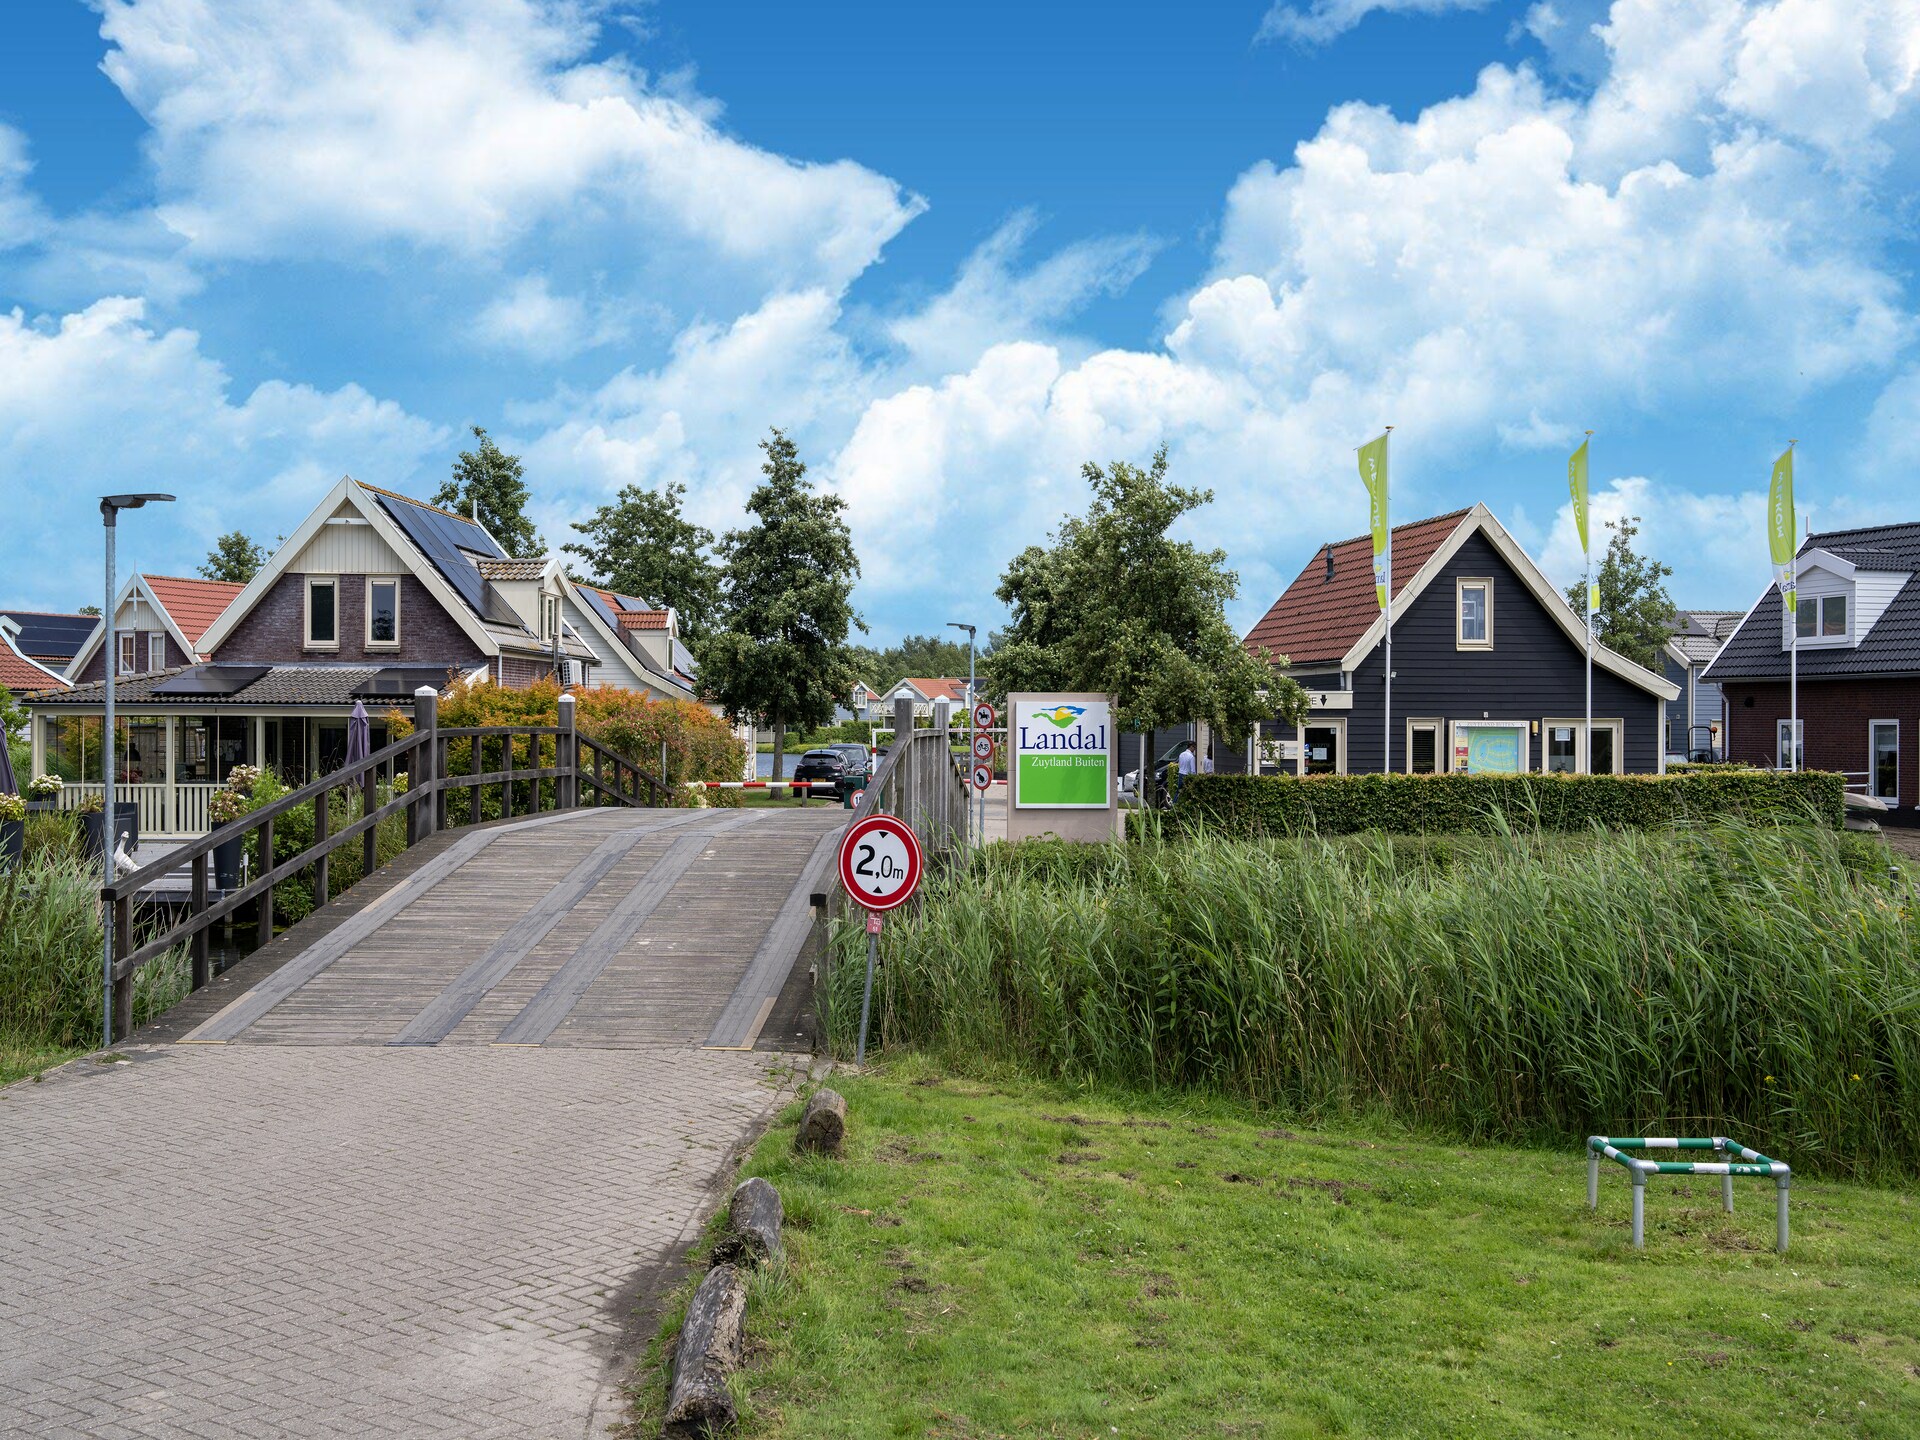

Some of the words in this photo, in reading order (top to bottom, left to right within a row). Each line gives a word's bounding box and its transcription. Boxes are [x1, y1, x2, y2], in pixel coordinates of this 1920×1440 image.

[1019, 725, 1107, 750] Landal
[1031, 756, 1073, 769] Zuytland
[1075, 757, 1105, 767] Buiten
